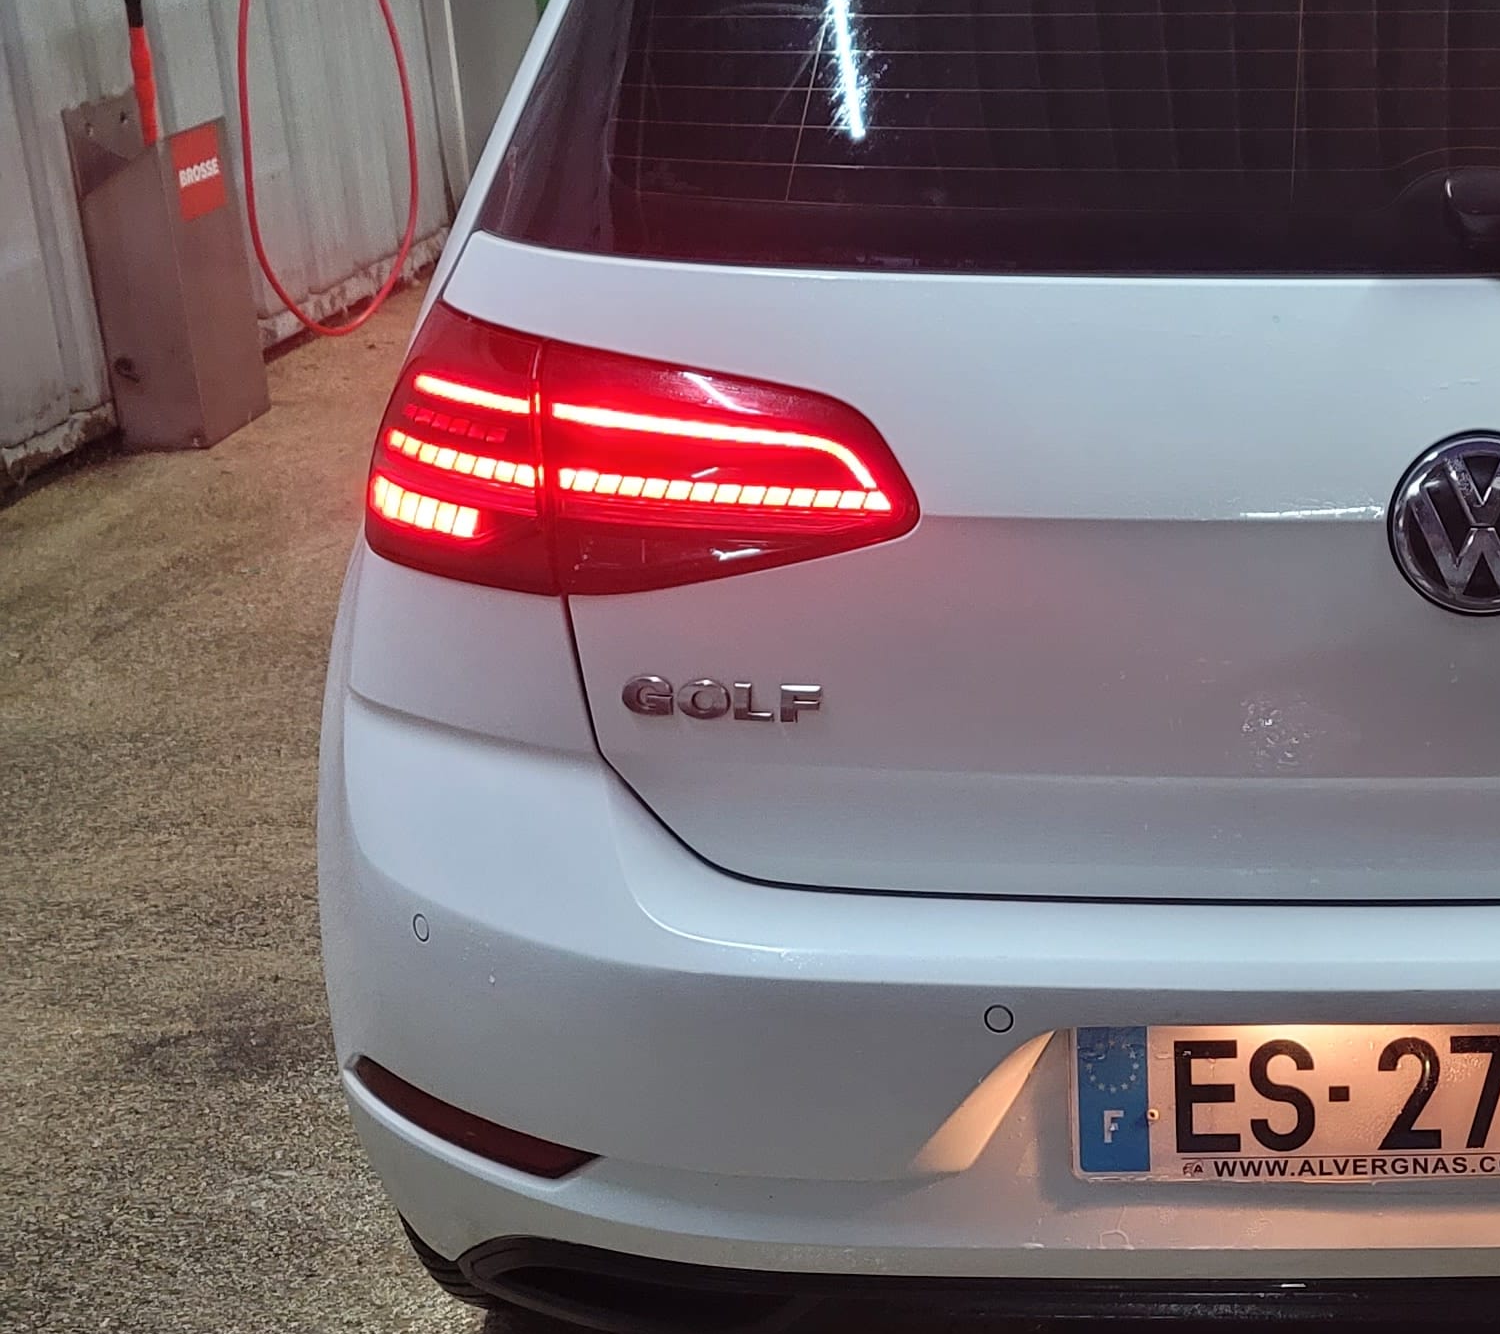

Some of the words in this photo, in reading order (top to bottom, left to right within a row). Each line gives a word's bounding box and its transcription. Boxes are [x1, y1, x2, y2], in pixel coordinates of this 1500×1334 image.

[178, 157, 220, 188] BROSSE
[621, 674, 823, 723] GOLF
[1103, 1110, 1124, 1143] F
